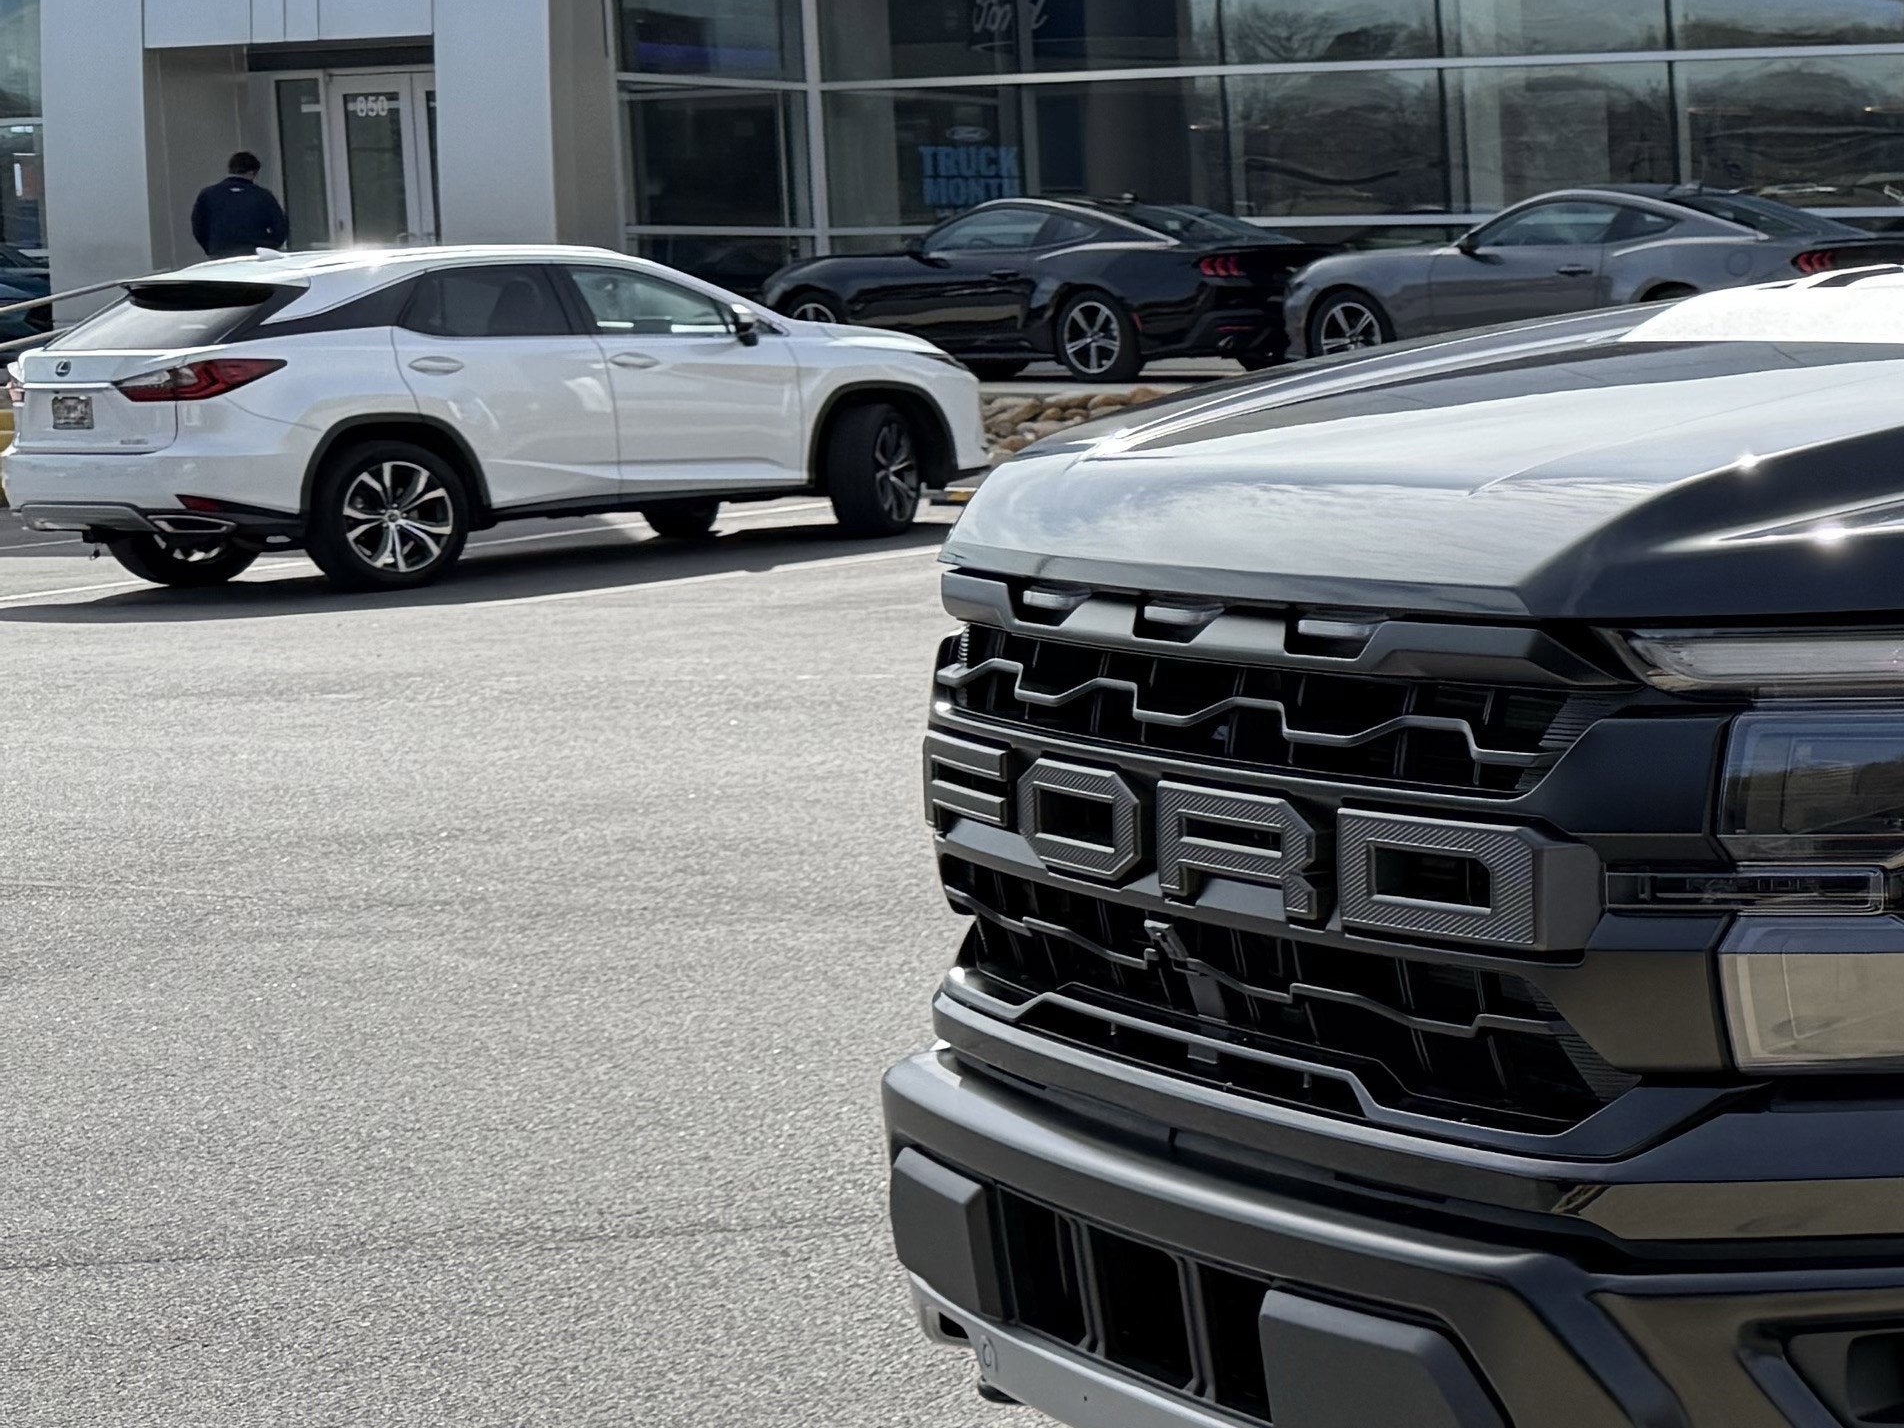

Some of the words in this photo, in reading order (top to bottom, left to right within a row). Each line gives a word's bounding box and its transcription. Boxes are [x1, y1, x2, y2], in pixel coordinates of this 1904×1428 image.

[919, 145, 1019, 176] TRUCK
[923, 177, 1020, 205] MONTH
[922, 732, 1545, 950] FORD
